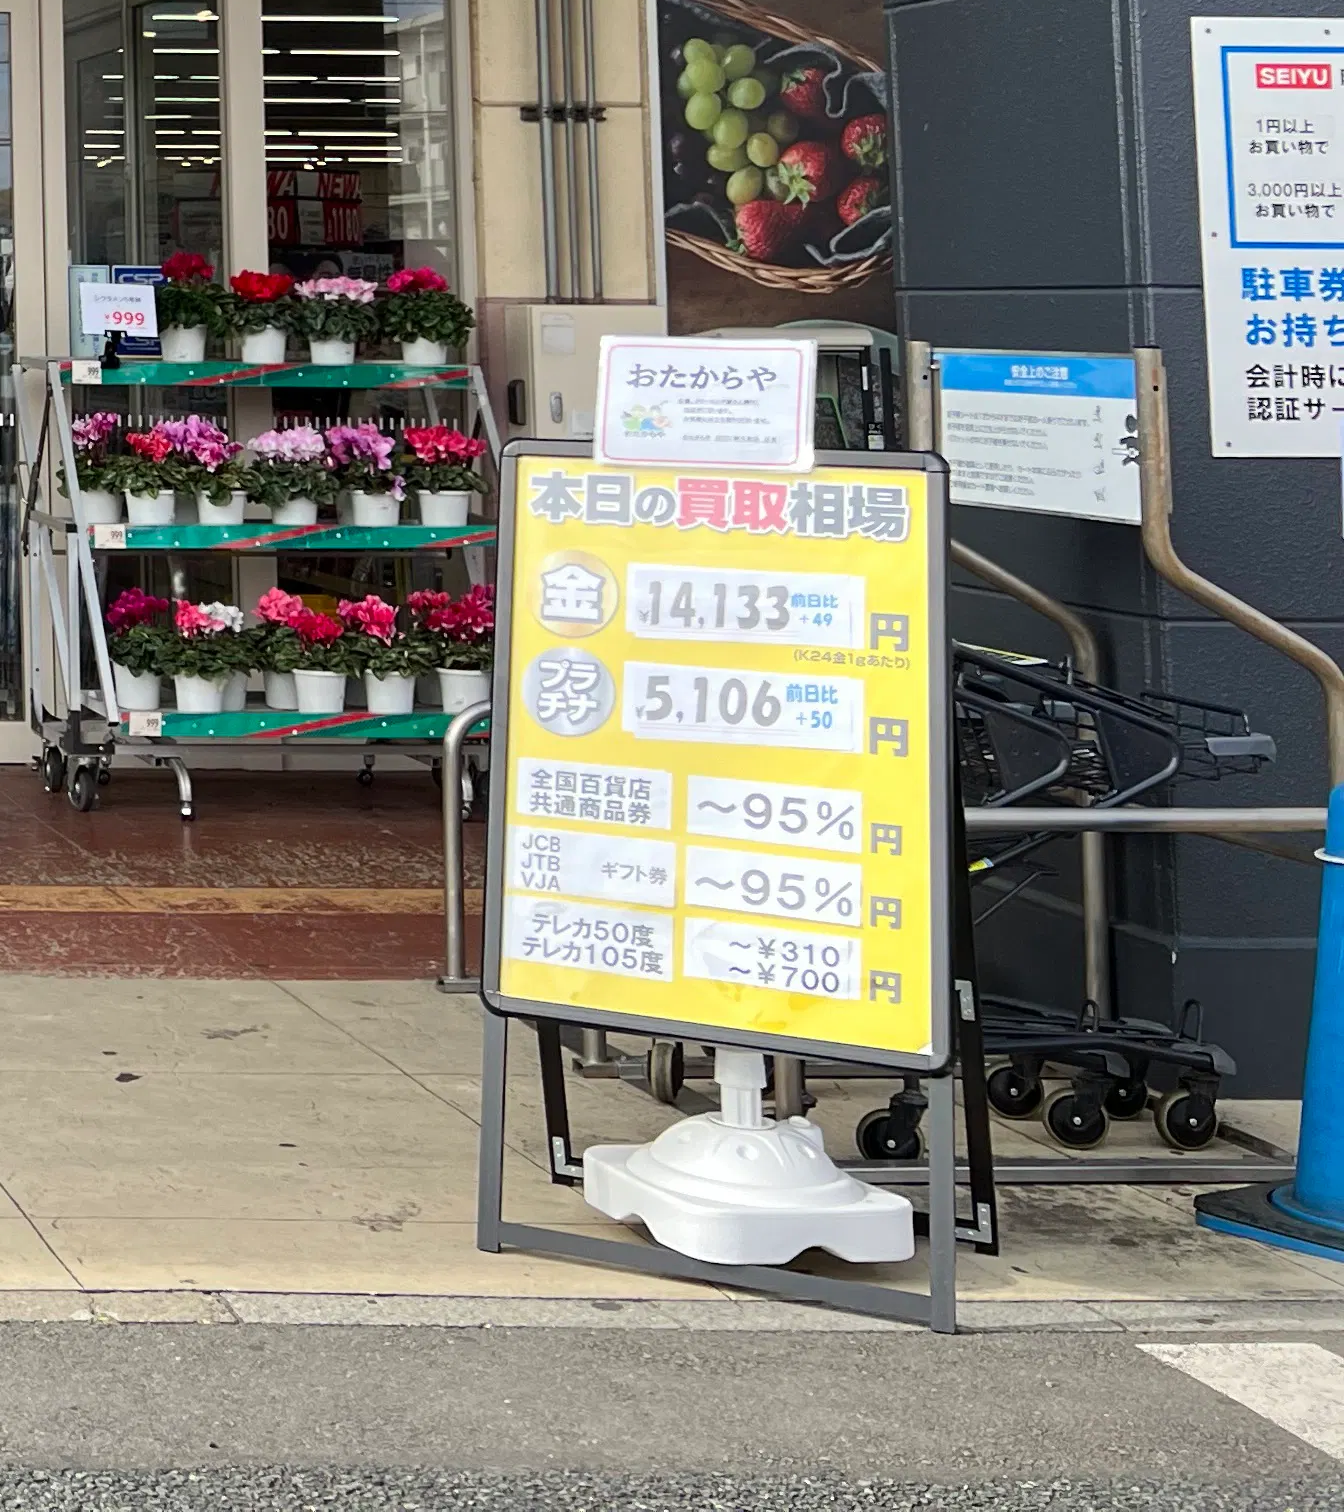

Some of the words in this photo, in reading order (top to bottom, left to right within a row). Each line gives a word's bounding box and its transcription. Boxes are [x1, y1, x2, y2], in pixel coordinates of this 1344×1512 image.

[1260, 68, 1328, 85] SEIYU
[1256, 119, 1314, 134] 1円以上
[1248, 140, 1329, 155] お買い物で
[1255, 204, 1336, 219] お買い物で
[1240, 266, 1344, 302] 駐車券
[1246, 312, 1344, 348] お持ち
[626, 363, 778, 392] おたからや
[1245, 363, 1344, 389] 会計時に
[1247, 396, 1344, 422] 認証サー
[530, 472, 909, 540] 本日の買取相場
[540, 562, 604, 625] 金
[791, 592, 839, 609] 前日比
[799, 611, 833, 628] +49
[870, 613, 910, 652] 円
[793, 648, 911, 670] (K24金1gあたり)
[538, 659, 600, 689] プラ
[538, 692, 600, 725] チナ
[786, 683, 839, 705] 前日比
[795, 710, 833, 729] +50
[869, 716, 909, 758] 円
[530, 768, 652, 801] 全国百貨店
[529, 791, 652, 825] 共通商品券
[522, 834, 561, 853] JCB
[870, 822, 903, 856] 円
[521, 854, 561, 873] JTB
[600, 860, 668, 886] ギフト券
[520, 871, 561, 892] VJA
[870, 895, 902, 930] 円
[531, 913, 655, 949] テレカ50度
[521, 937, 664, 975] テレカ105度
[869, 969, 902, 1005] 円
